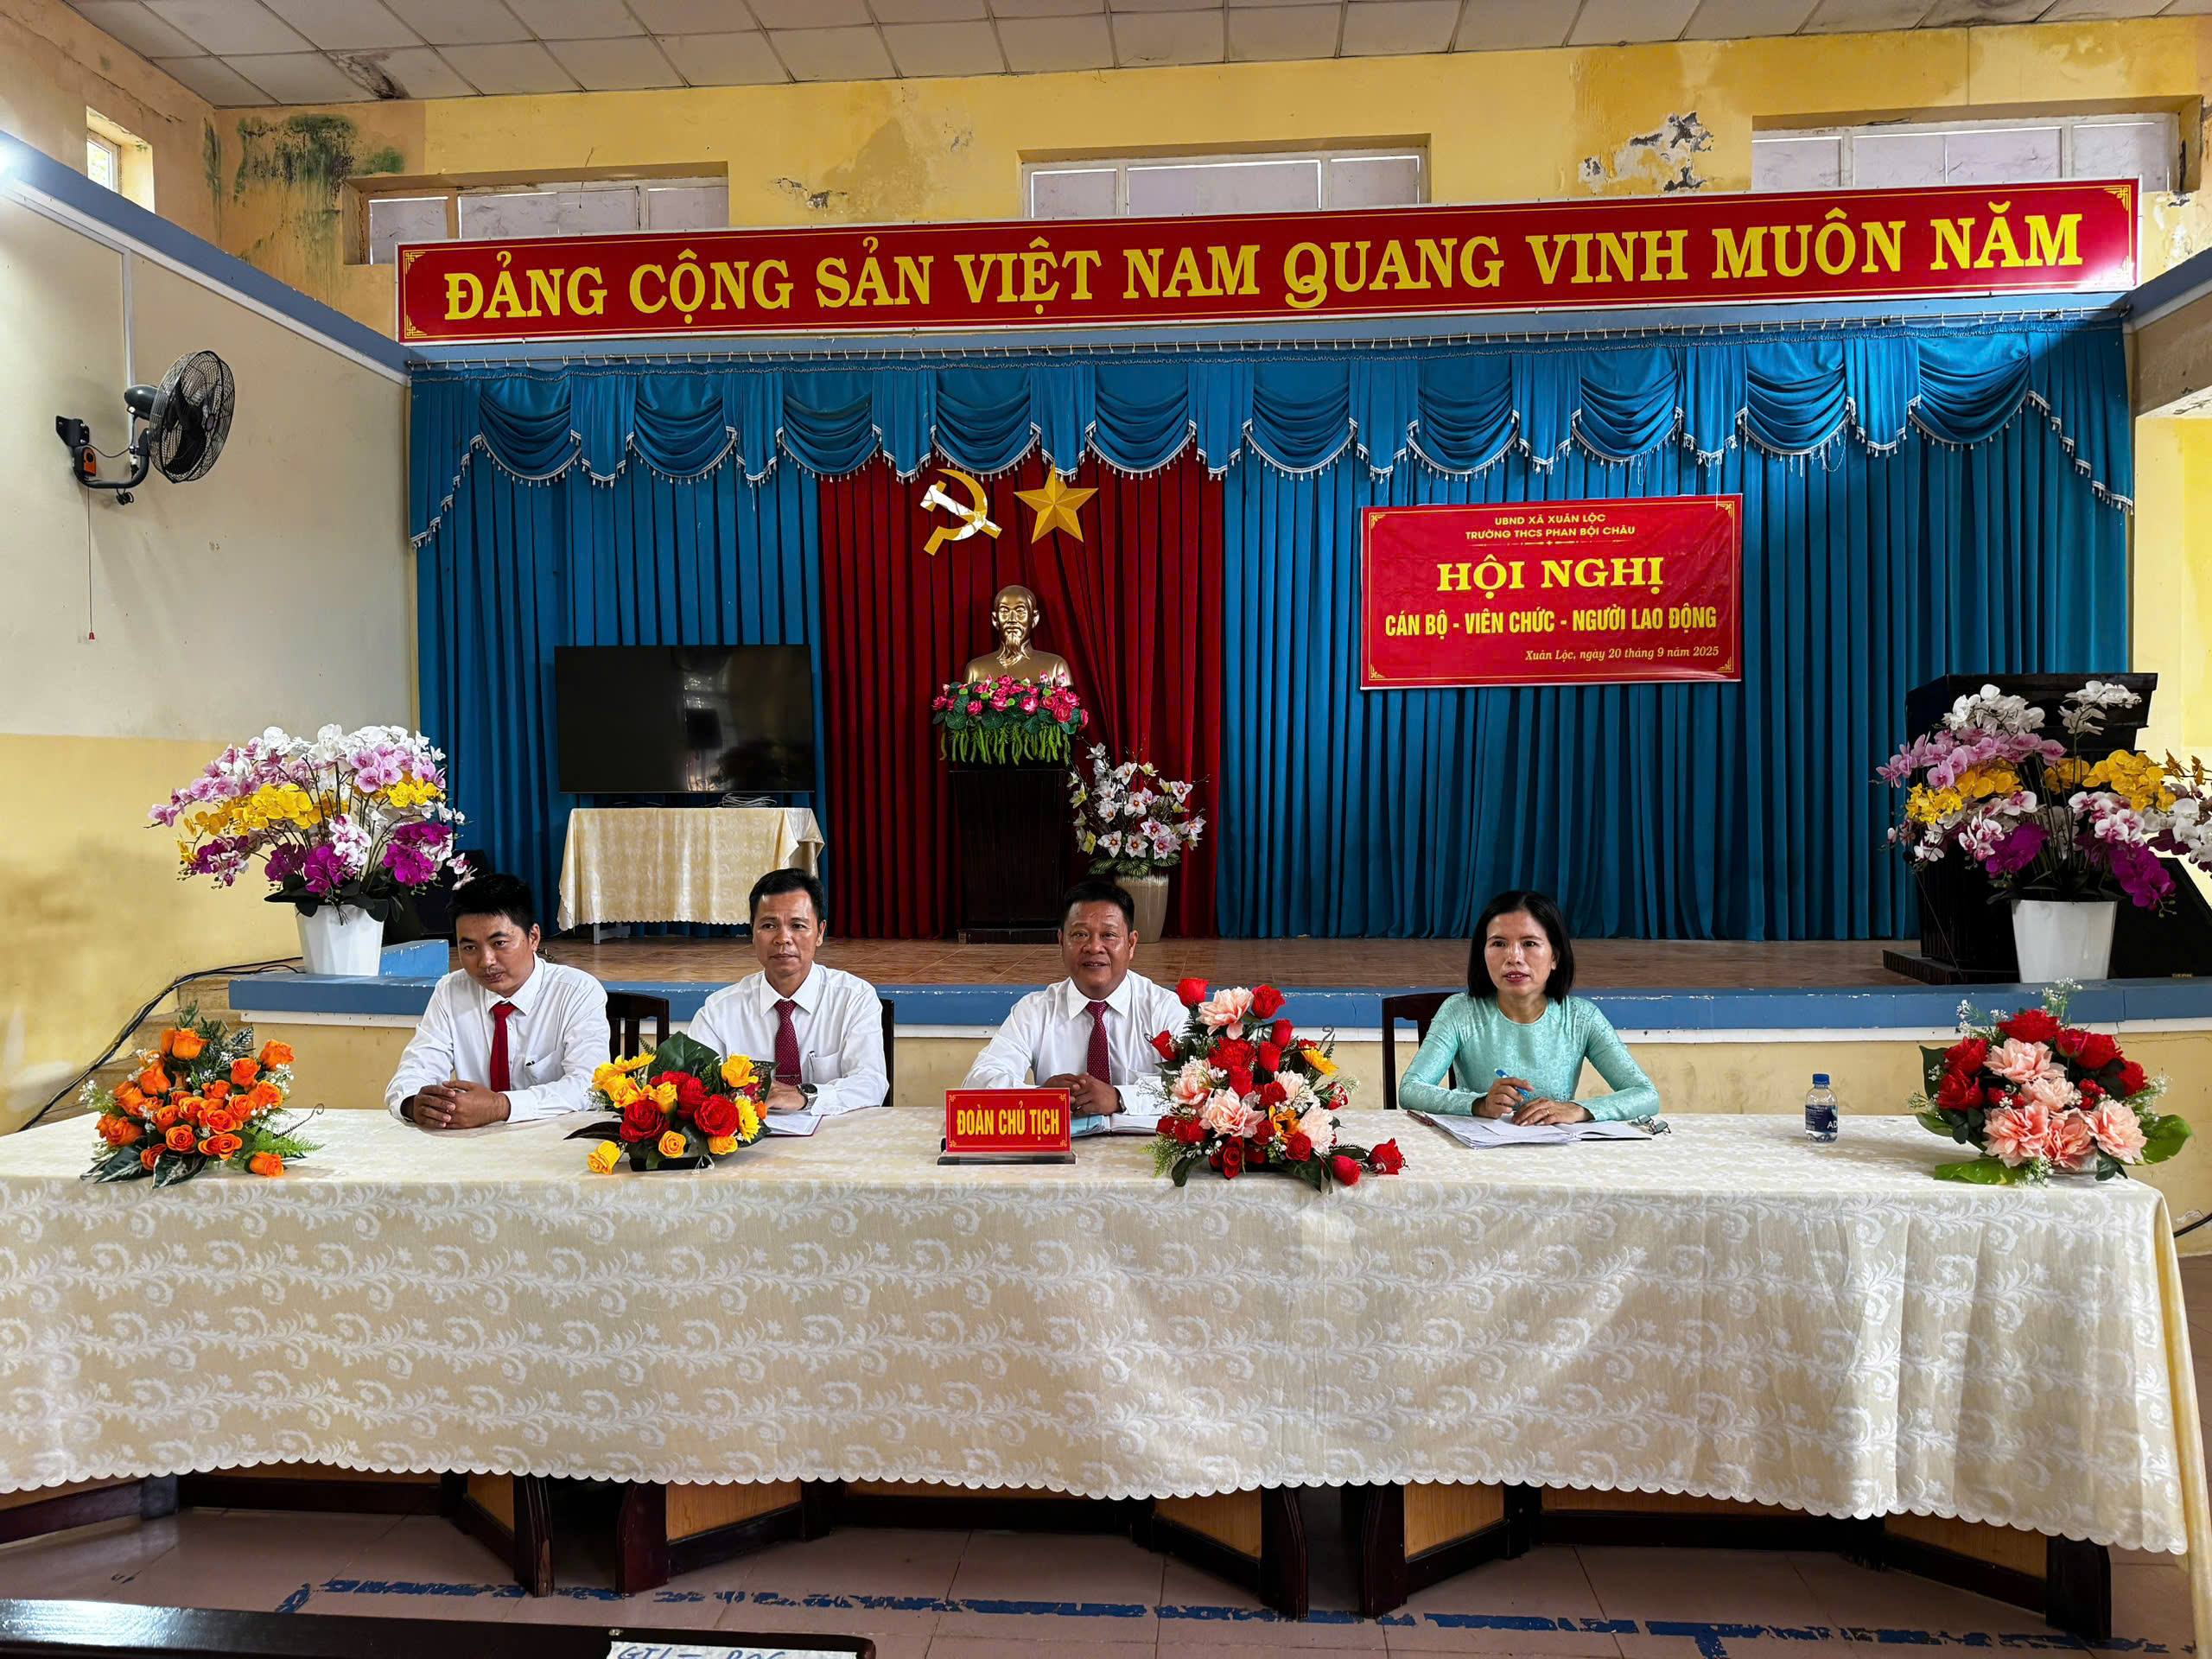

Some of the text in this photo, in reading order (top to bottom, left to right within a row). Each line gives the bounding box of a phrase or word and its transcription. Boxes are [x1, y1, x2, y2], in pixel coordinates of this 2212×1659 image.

[444, 200, 2084, 324] ĐẢNG CỘNG SẢN VIỆT NAM QUANG VINH MUÔN NĂM
[1465, 525, 1636, 540] TRƯỜNG THCS PHAN BỘI CHÂU
[1495, 512, 1606, 525] UBND XÃ XUÂN LỘC
[1436, 554, 1664, 599] HỘI NGHỊ
[1385, 610, 1420, 636] CÁN
[1425, 608, 1448, 640] BỘ
[1465, 607, 1503, 634] VIÊN
[1509, 606, 1555, 633] CHỨC
[1573, 603, 1626, 632] NGƯỜI
[1631, 607, 1663, 630] LAO
[1669, 602, 1717, 633] ĐỘNG
[1525, 646, 1719, 662] Xuân Lộc, ngày 20 tháng 9 năm 2025
[957, 1100, 1060, 1141] ĐOÀN CHỦ TỊCH
